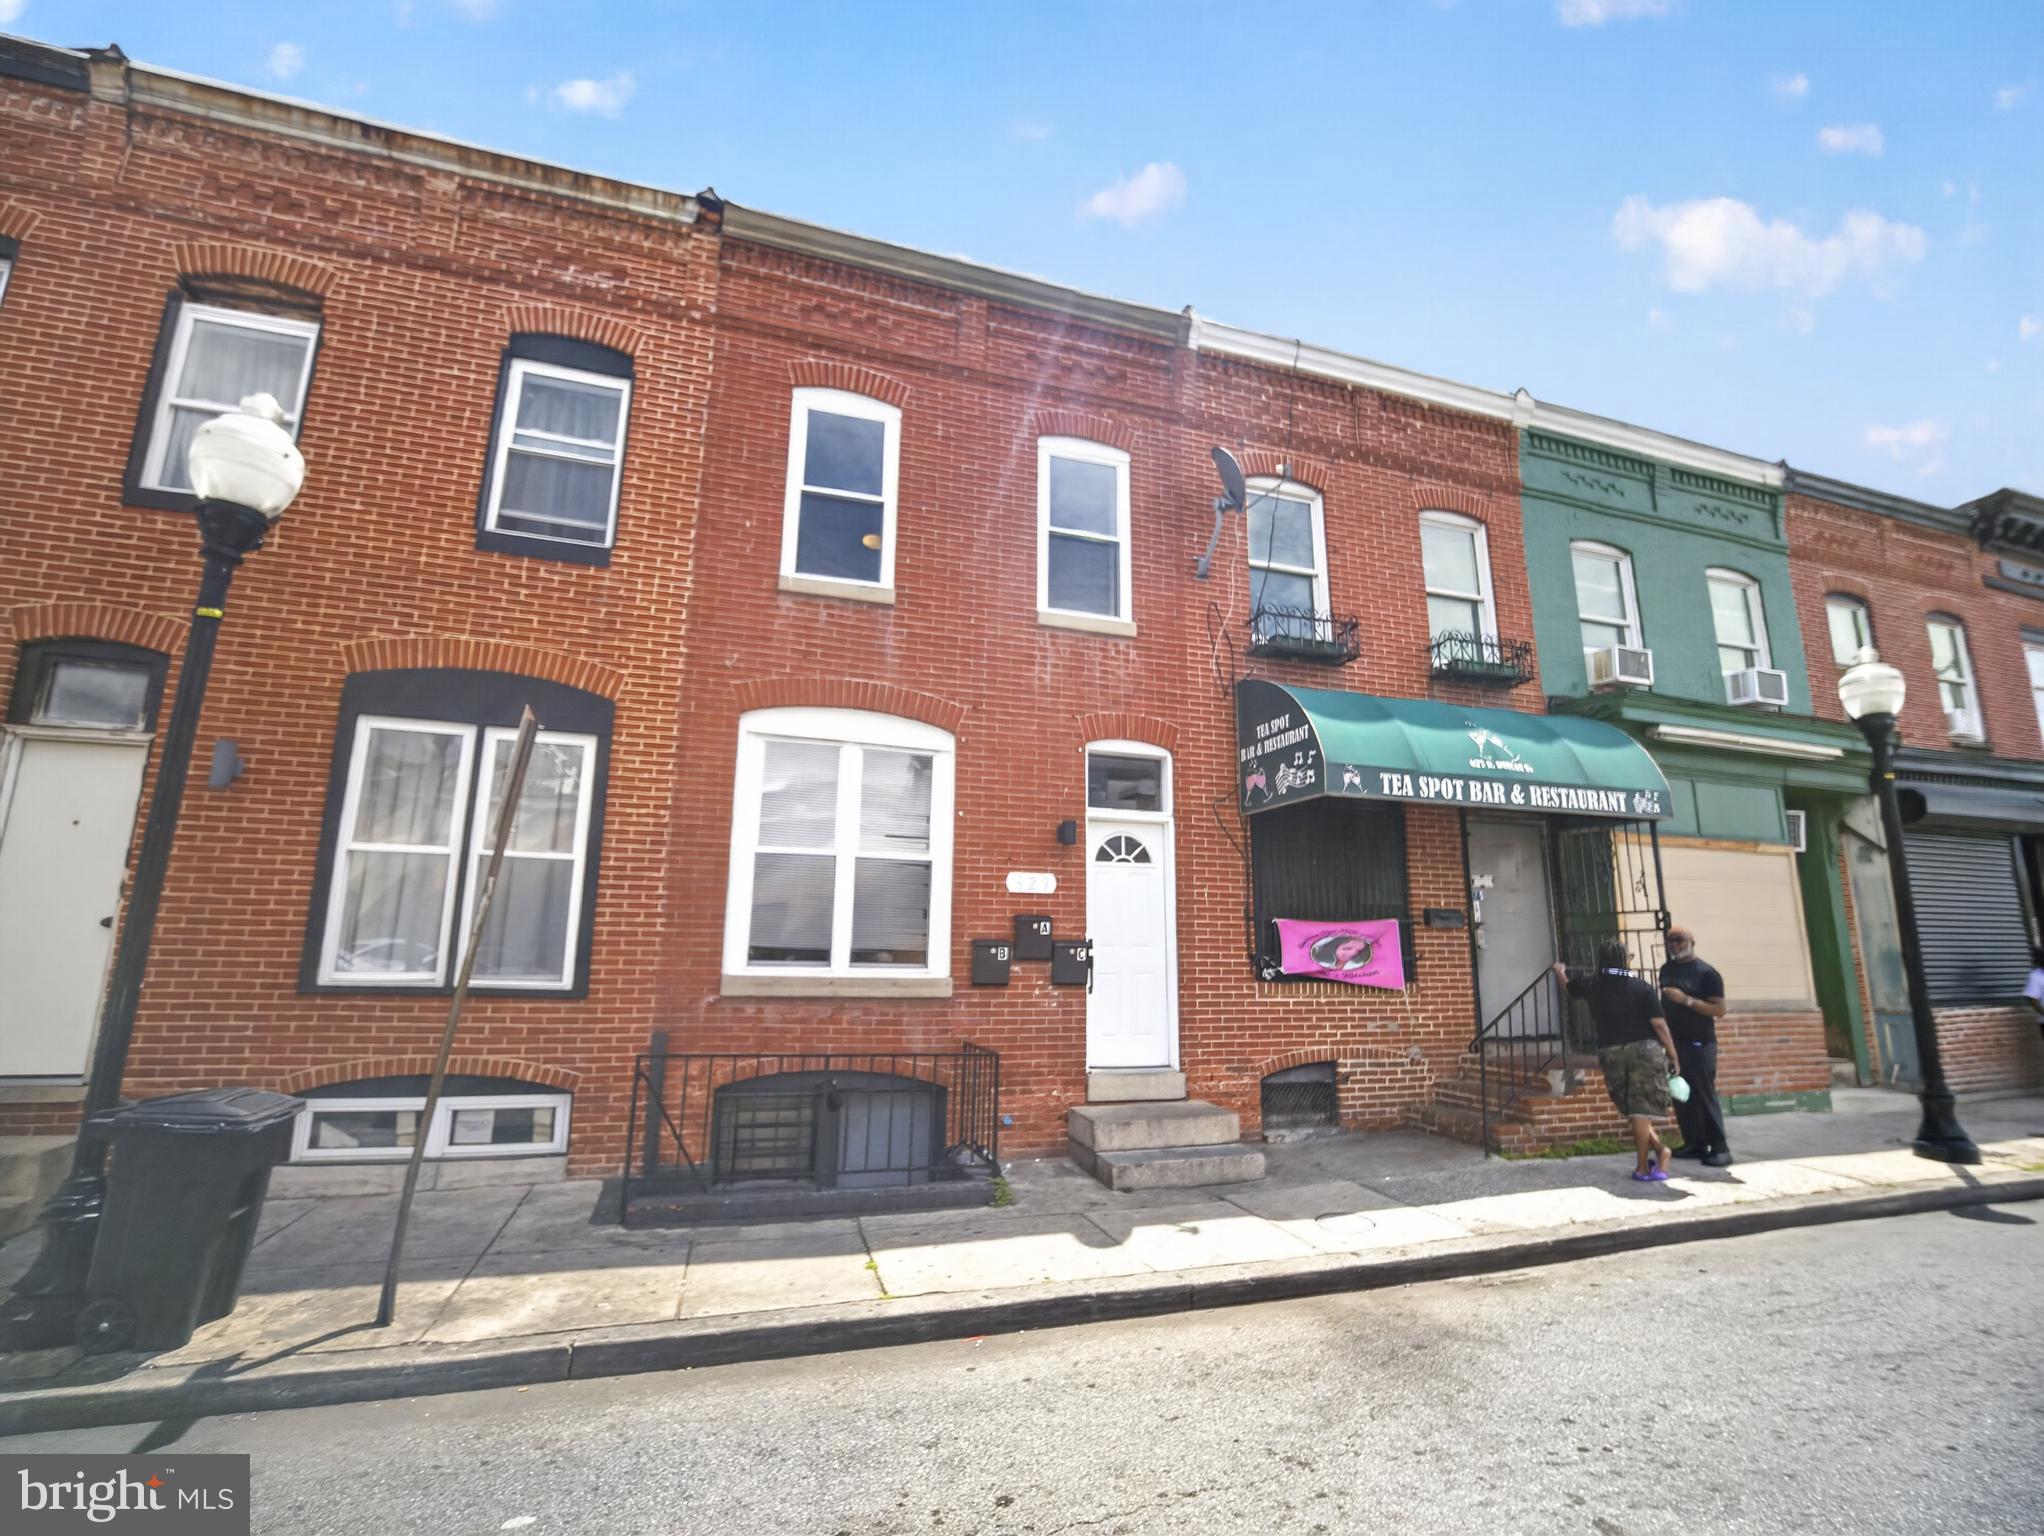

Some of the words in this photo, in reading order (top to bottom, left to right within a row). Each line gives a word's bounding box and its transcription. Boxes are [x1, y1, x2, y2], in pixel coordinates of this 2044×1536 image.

[1256, 722, 1270, 739] TEA
[1270, 713, 1290, 734] SPOT
[1240, 745, 1255, 763] BAR
[1256, 742, 1263, 757] &
[1264, 724, 1309, 754] RESTAURANT
[1379, 772, 1414, 796] TEA
[1418, 775, 1464, 801] SPOT
[1468, 780, 1506, 804] BAR
[1510, 783, 1525, 805] &
[1529, 785, 1627, 812] RESTAURANT
[1041, 923, 1049, 934] A
[999, 948, 1007, 959] B
[1078, 949, 1085, 960] C
